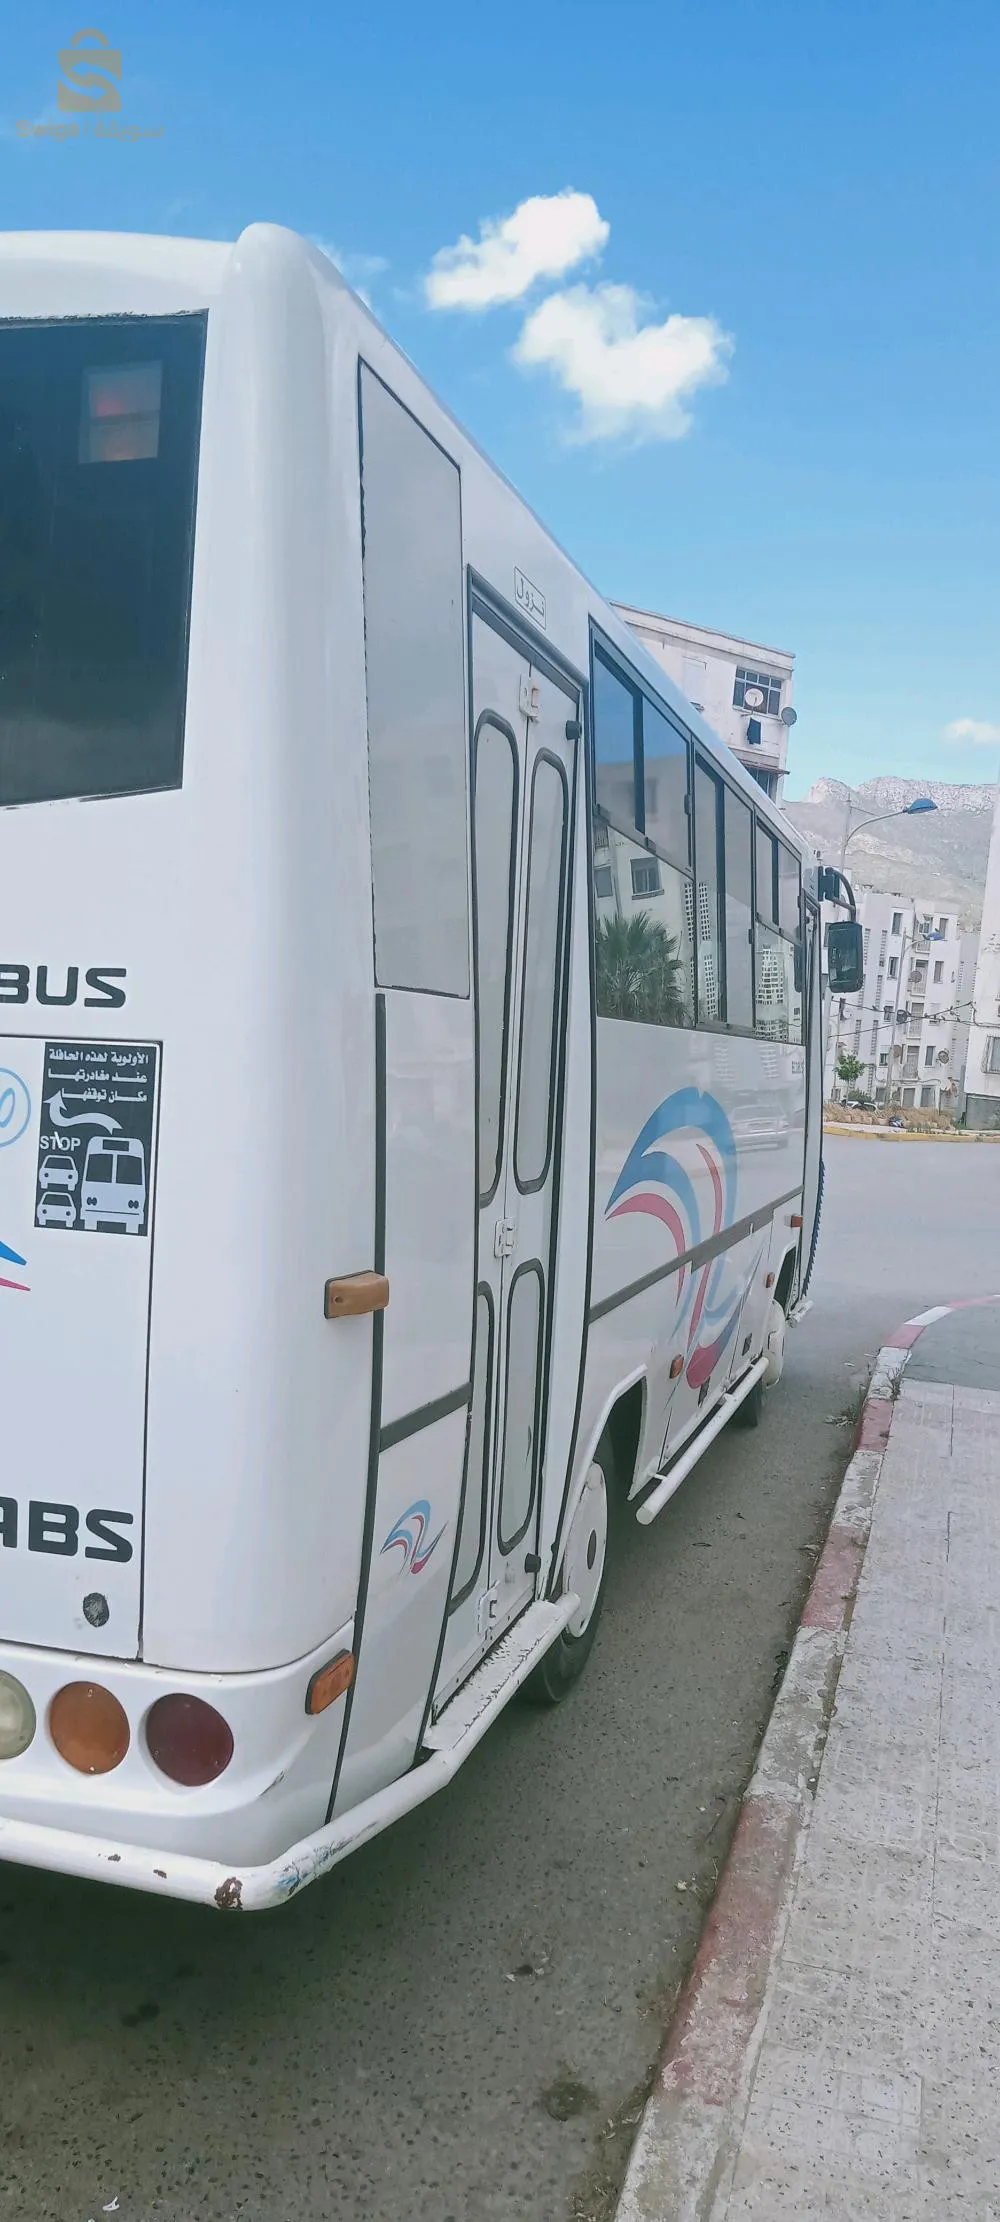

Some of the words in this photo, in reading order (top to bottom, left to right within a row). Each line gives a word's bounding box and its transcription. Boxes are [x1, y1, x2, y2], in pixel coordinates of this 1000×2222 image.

[49, 1048, 83, 1062] الحافلة
[85, 1052, 108, 1063] لهذه
[110, 1052, 149, 1066] الأولوية
[111, 1072, 148, 1083] عند
[39, 1135, 81, 1151] STOP
